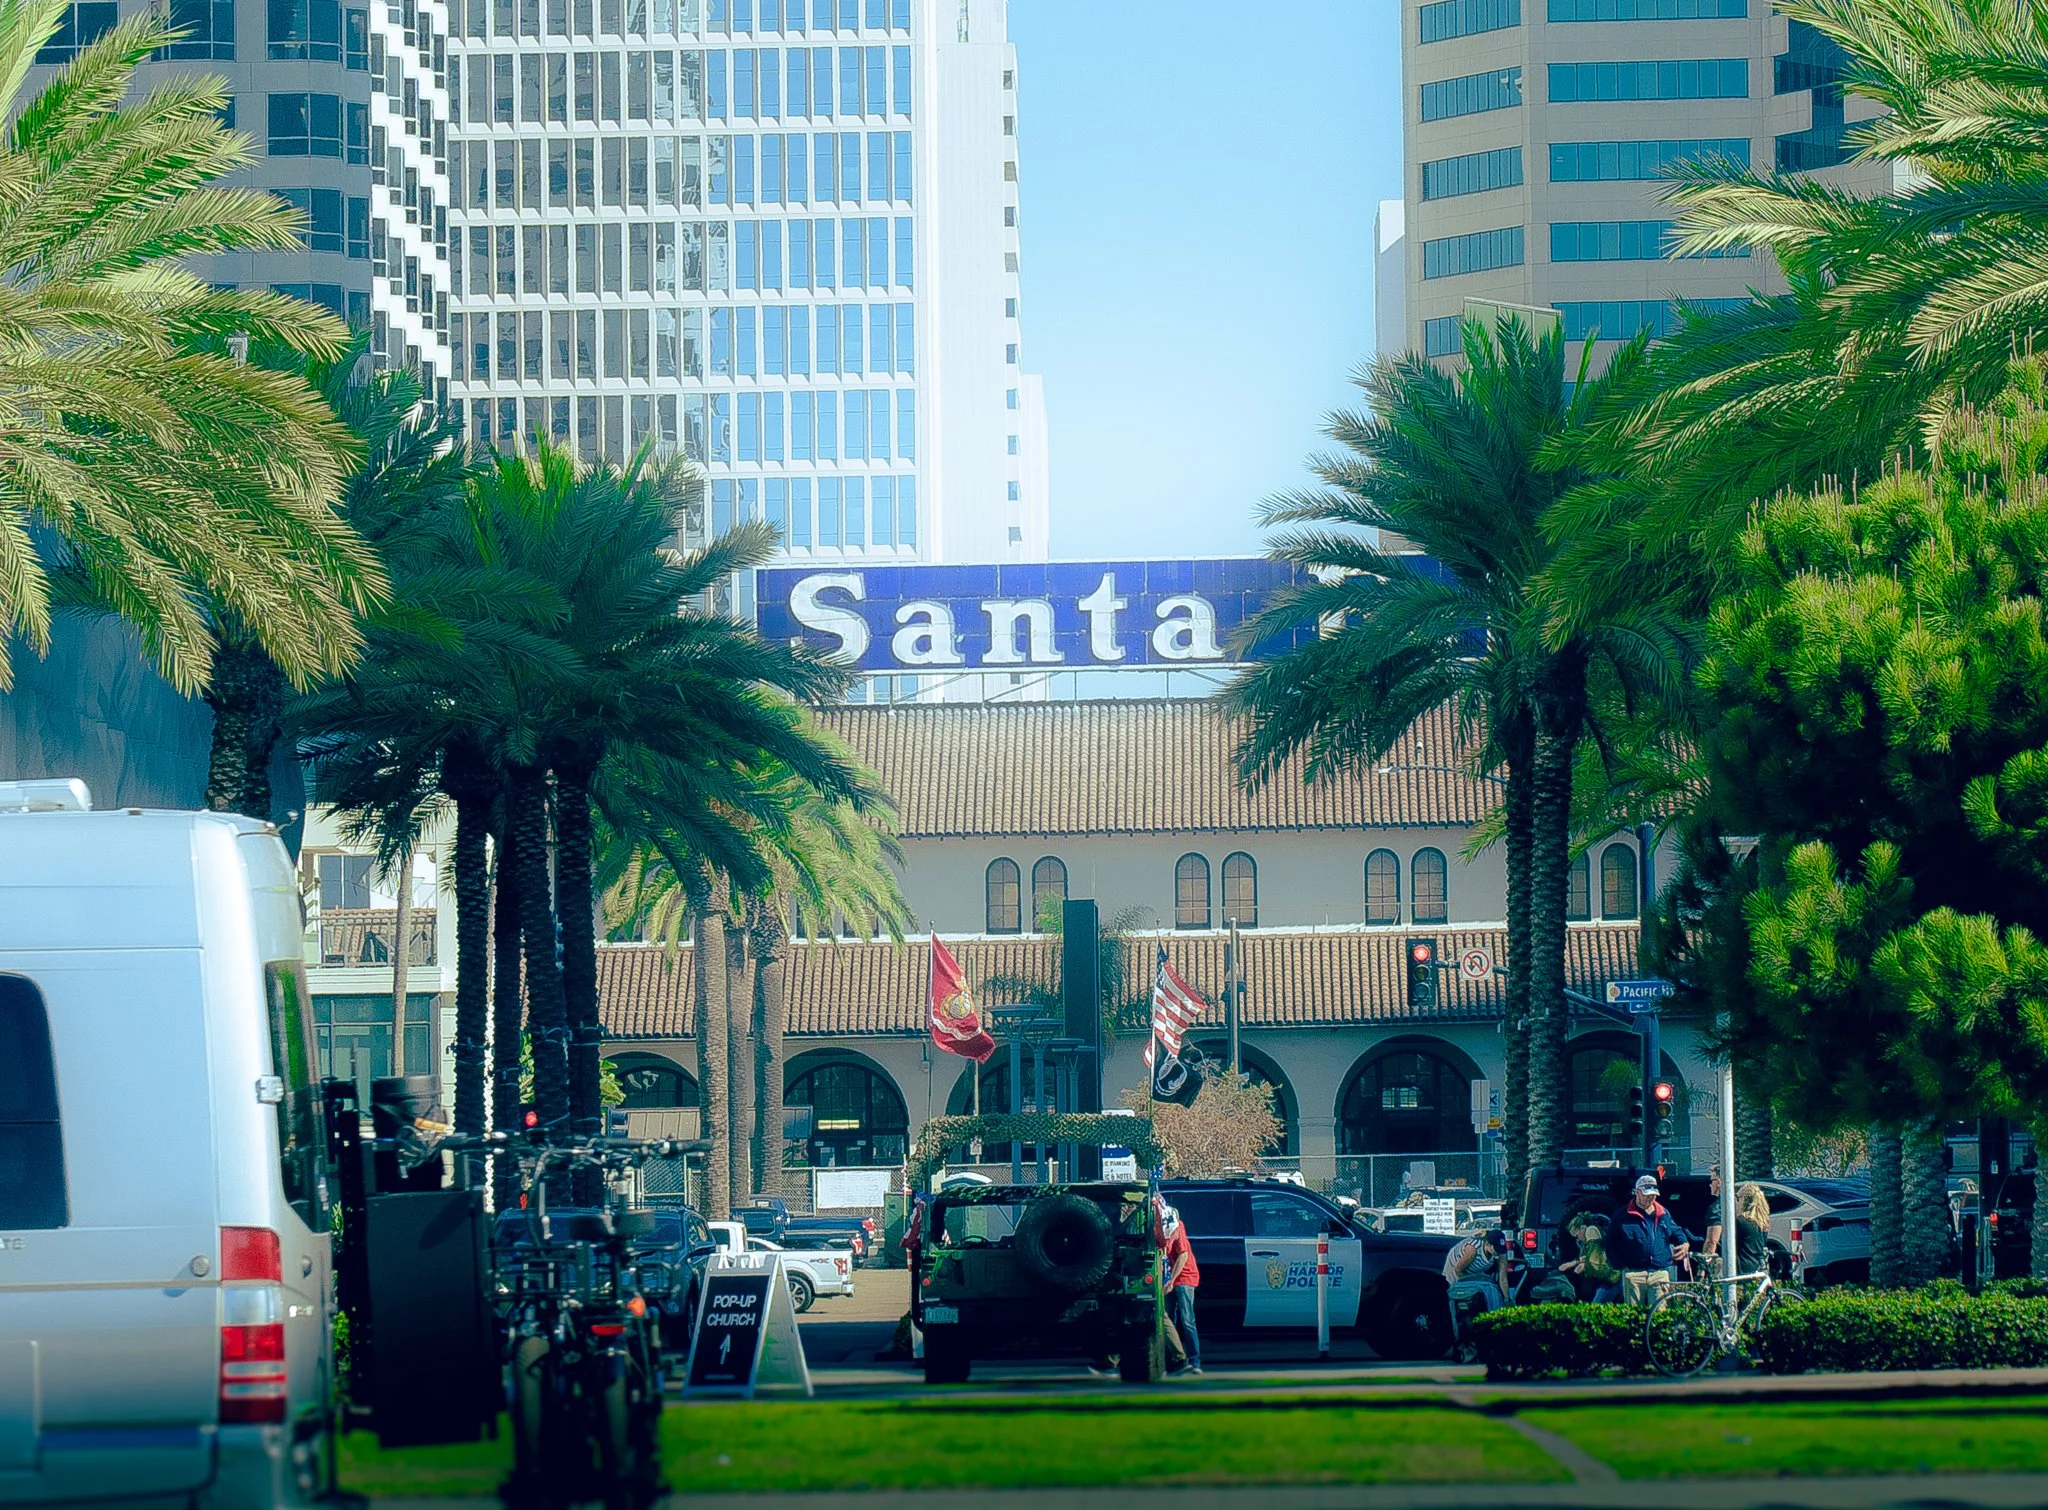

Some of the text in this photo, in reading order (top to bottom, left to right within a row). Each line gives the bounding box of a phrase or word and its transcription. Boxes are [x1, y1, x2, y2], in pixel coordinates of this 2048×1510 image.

[788, 571, 1226, 665] Santa
[1623, 985, 1658, 998] PACIFIC
[1289, 1266, 1343, 1276] HAROR
[1286, 1276, 1342, 1287] POLE
[713, 1294, 757, 1308] POP-UP
[706, 1313, 757, 1327] CHURCH
